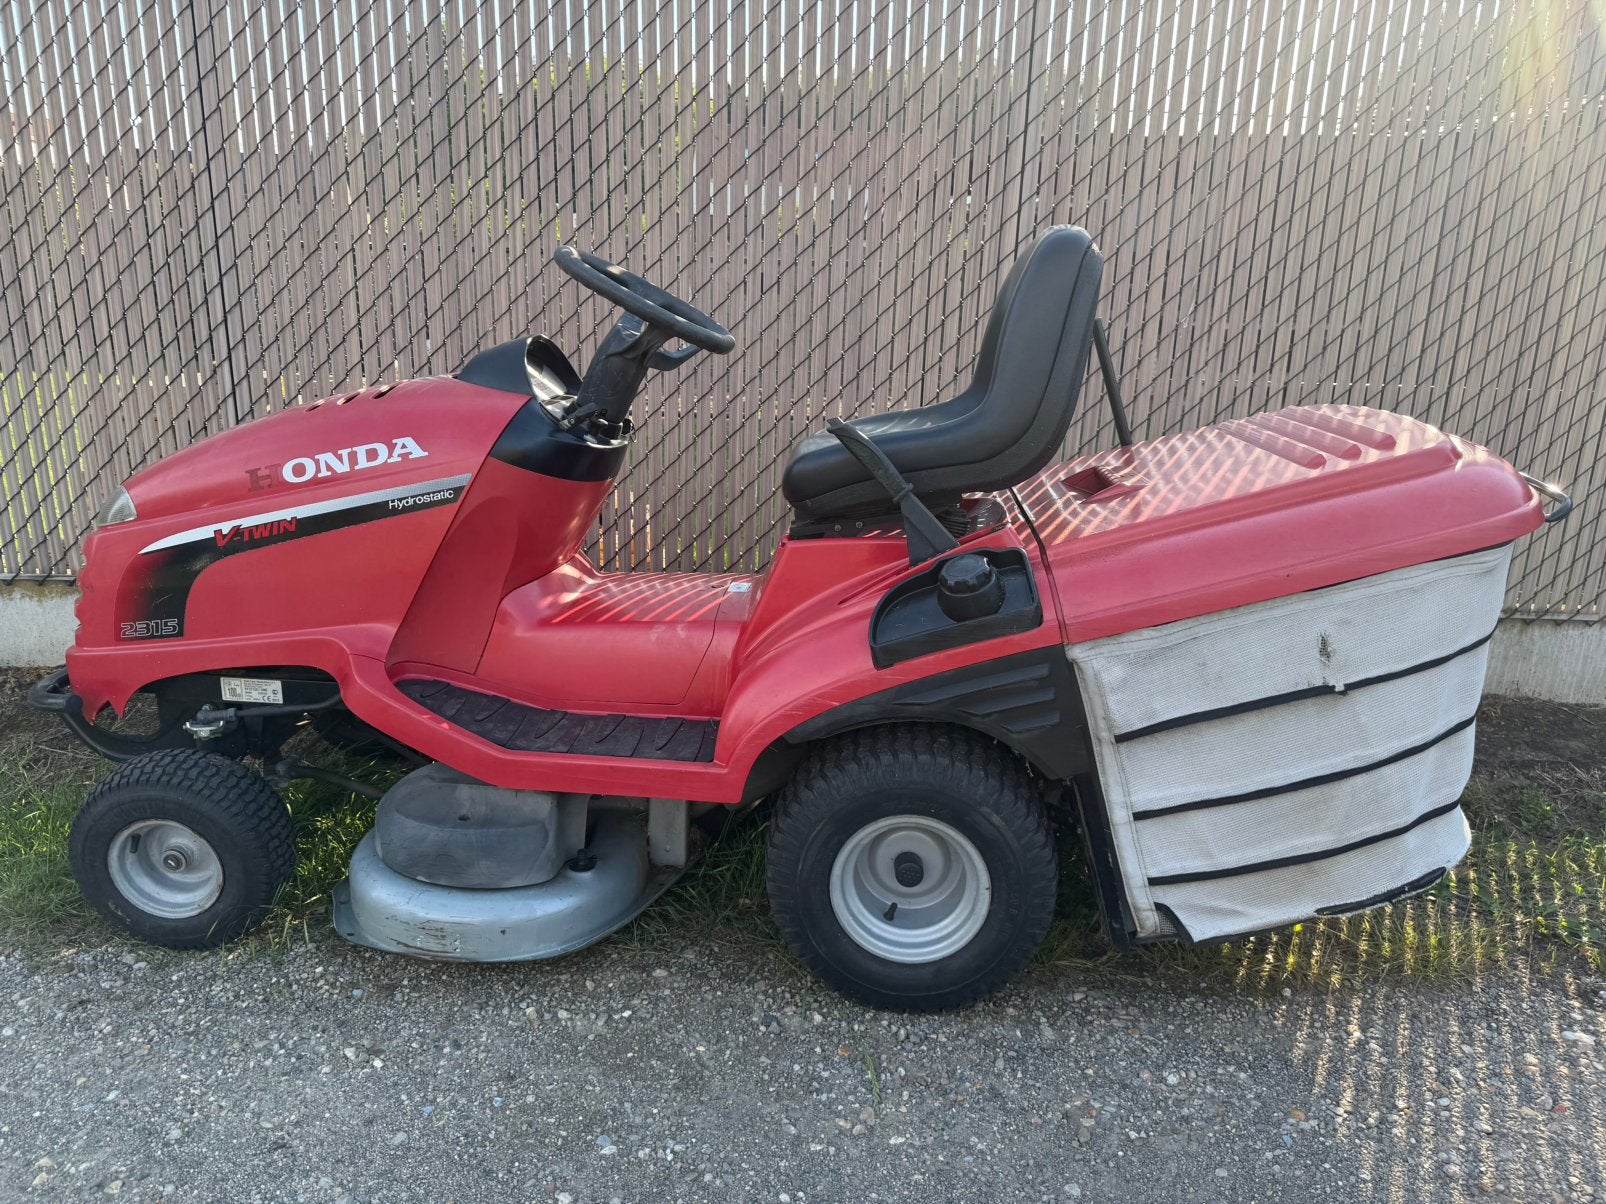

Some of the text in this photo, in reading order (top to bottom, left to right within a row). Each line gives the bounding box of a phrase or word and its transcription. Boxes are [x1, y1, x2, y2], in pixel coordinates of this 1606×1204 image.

[245, 436, 428, 491] HONDA
[388, 490, 454, 510] Hydrostatic
[214, 516, 298, 547] V-TWIN
[120, 618, 179, 638] 2315
